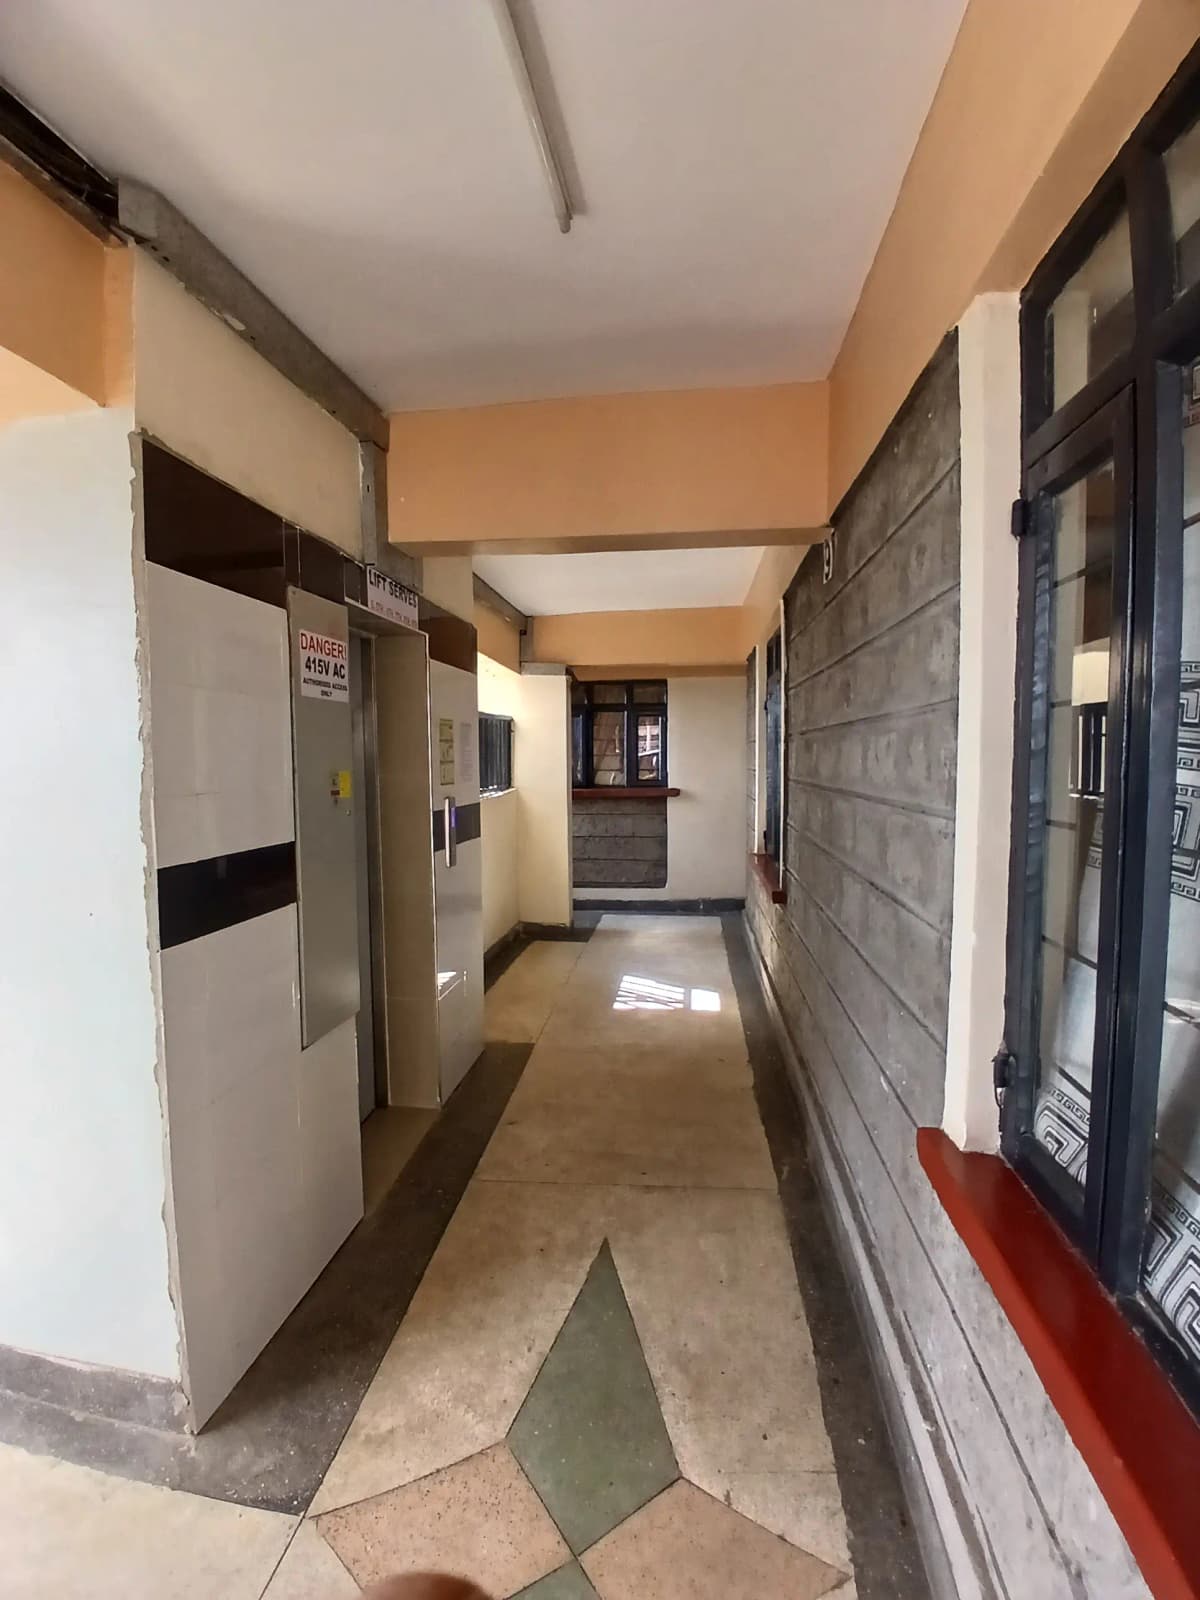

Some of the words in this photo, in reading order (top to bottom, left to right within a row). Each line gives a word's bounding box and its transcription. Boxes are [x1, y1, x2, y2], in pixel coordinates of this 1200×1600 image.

[369, 569, 387, 591] LIFT
[389, 581, 416, 609] SERVES
[300, 632, 347, 660] DANGER!
[305, 655, 330, 676] 415V
[333, 662, 346, 679] AC
